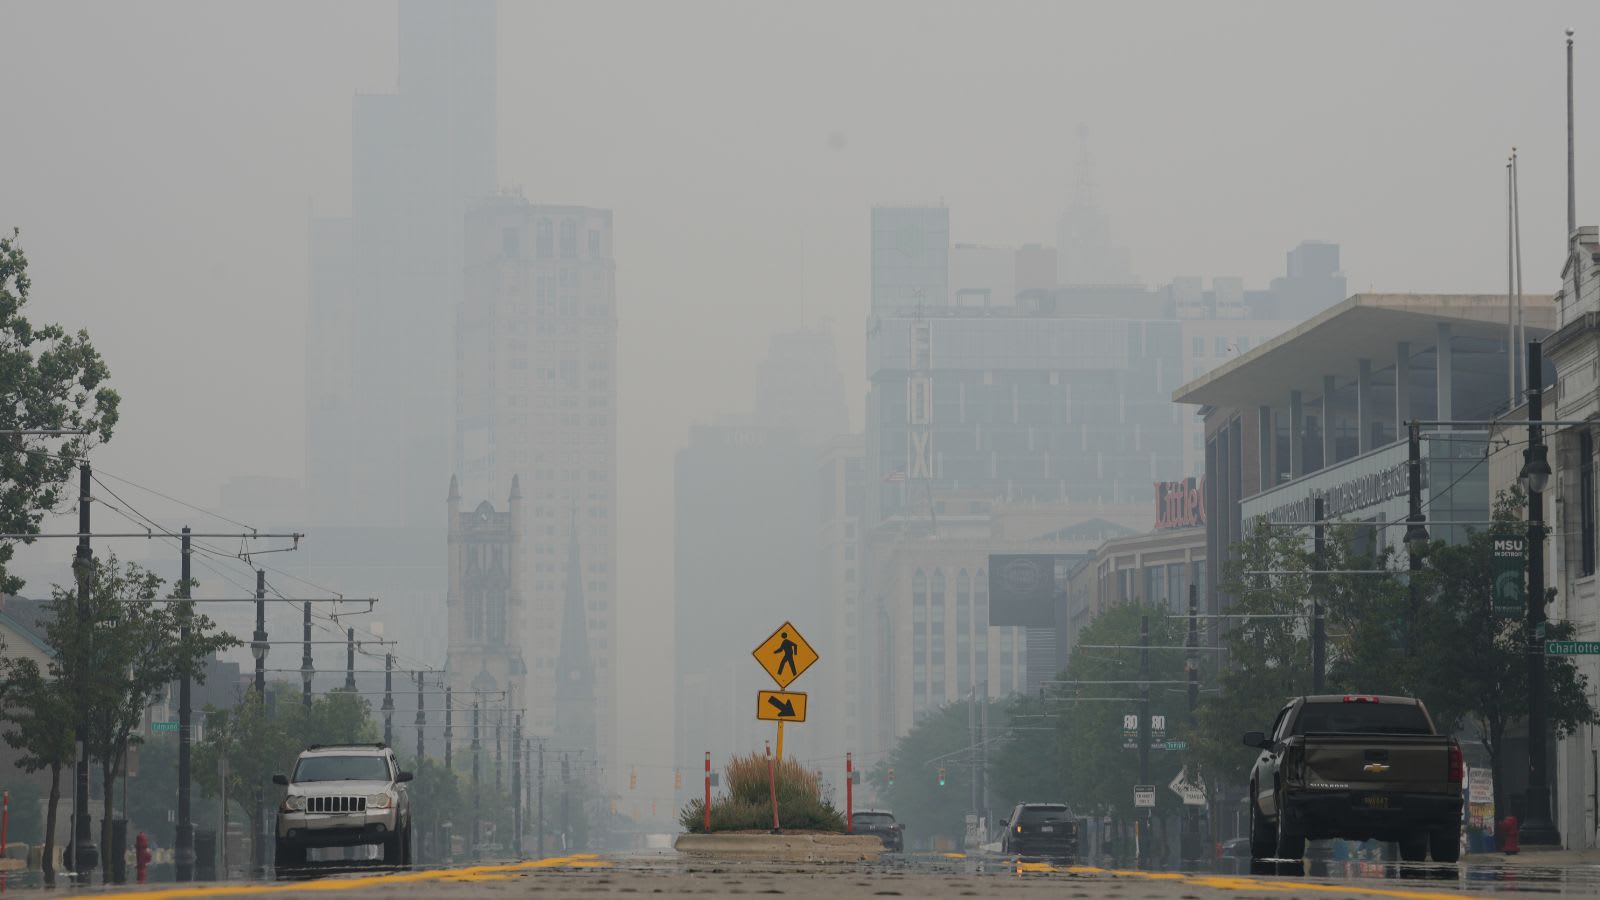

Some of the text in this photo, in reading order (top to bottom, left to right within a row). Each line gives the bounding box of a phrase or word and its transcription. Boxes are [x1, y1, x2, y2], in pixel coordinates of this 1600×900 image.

[909, 322, 931, 478] FOX
[1153, 478, 1197, 528] Little
[1494, 540, 1522, 551] MSU
[1549, 642, 1599, 654] Charlotte
